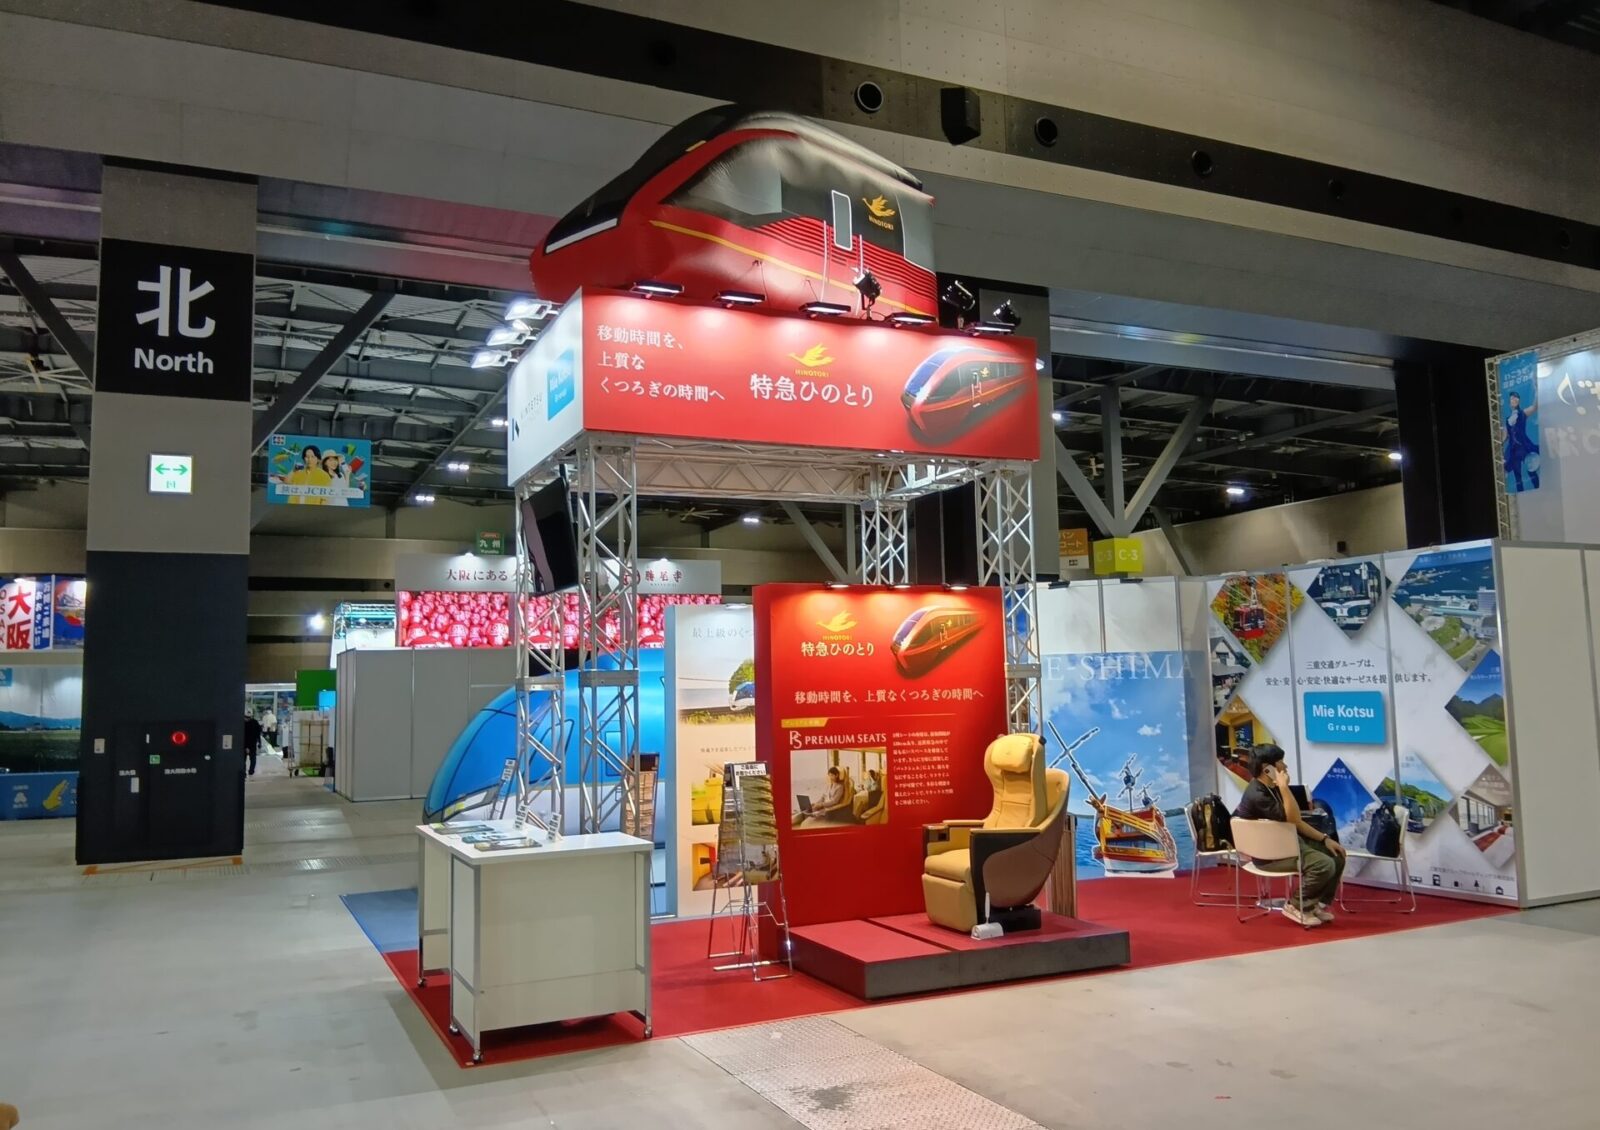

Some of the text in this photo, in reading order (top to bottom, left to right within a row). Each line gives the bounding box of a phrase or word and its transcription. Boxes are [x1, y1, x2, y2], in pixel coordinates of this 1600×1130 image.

[136, 265, 216, 338] 北
[597, 325, 684, 349] 移動時間を、
[134, 348, 214, 374] North
[597, 351, 645, 370] 上質な
[600, 376, 725, 401] くつろぎの時間へ
[750, 373, 874, 408] 特急ひのとり
[479, 539, 501, 549] 九州
[447, 568, 509, 582] 大阪にある
[7, 585, 32, 649] 大阪
[801, 641, 875, 657] 特急ひのとり
[1312, 705, 1374, 718] Mie Kotsu
[1327, 723, 1360, 732] Group
[804, 734, 855, 745] PREMIUM
[857, 733, 887, 743] SEATS
